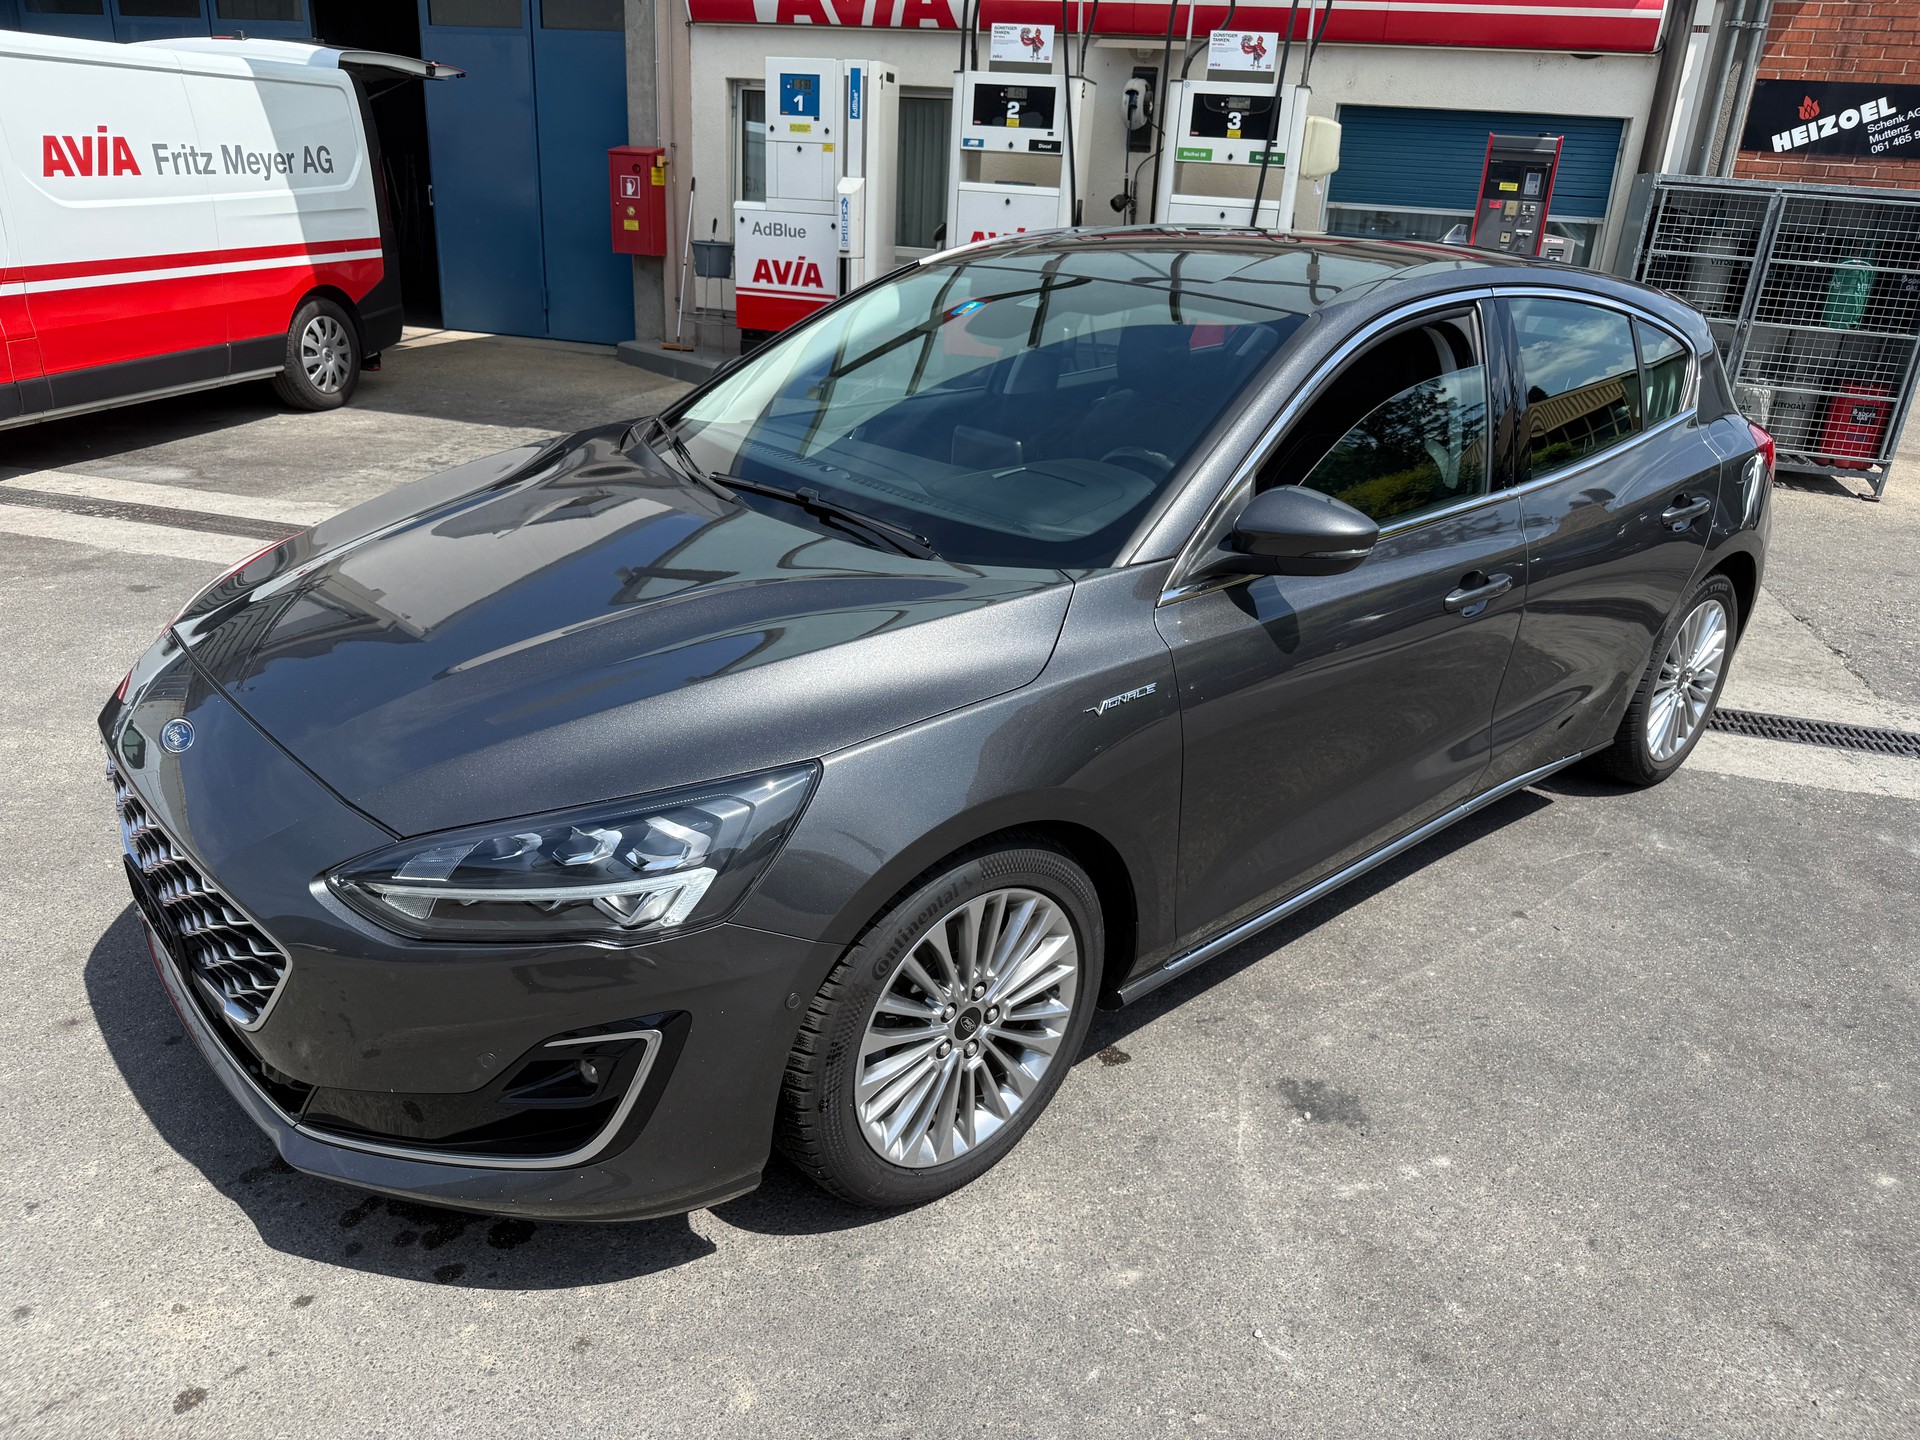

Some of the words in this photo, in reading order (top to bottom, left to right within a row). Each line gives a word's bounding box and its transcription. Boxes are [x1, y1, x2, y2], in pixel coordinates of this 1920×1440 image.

[793, 95, 804, 112] 1
[1006, 101, 1020, 119] 2
[1227, 111, 1242, 130] 3
[1771, 97, 1897, 153] HEIZOEL
[1867, 114, 1906, 133] Schenk
[1869, 125, 1911, 144] Muttenz
[1871, 140, 1890, 154] 061
[1892, 133, 1913, 147] 465
[152, 143, 217, 175] Fritz
[221, 144, 295, 181] Meyer
[303, 145, 335, 174] AG
[752, 221, 807, 239] AdBlue
[1083, 682, 1157, 716] VIGNALE
[872, 882, 960, 980] Continental
